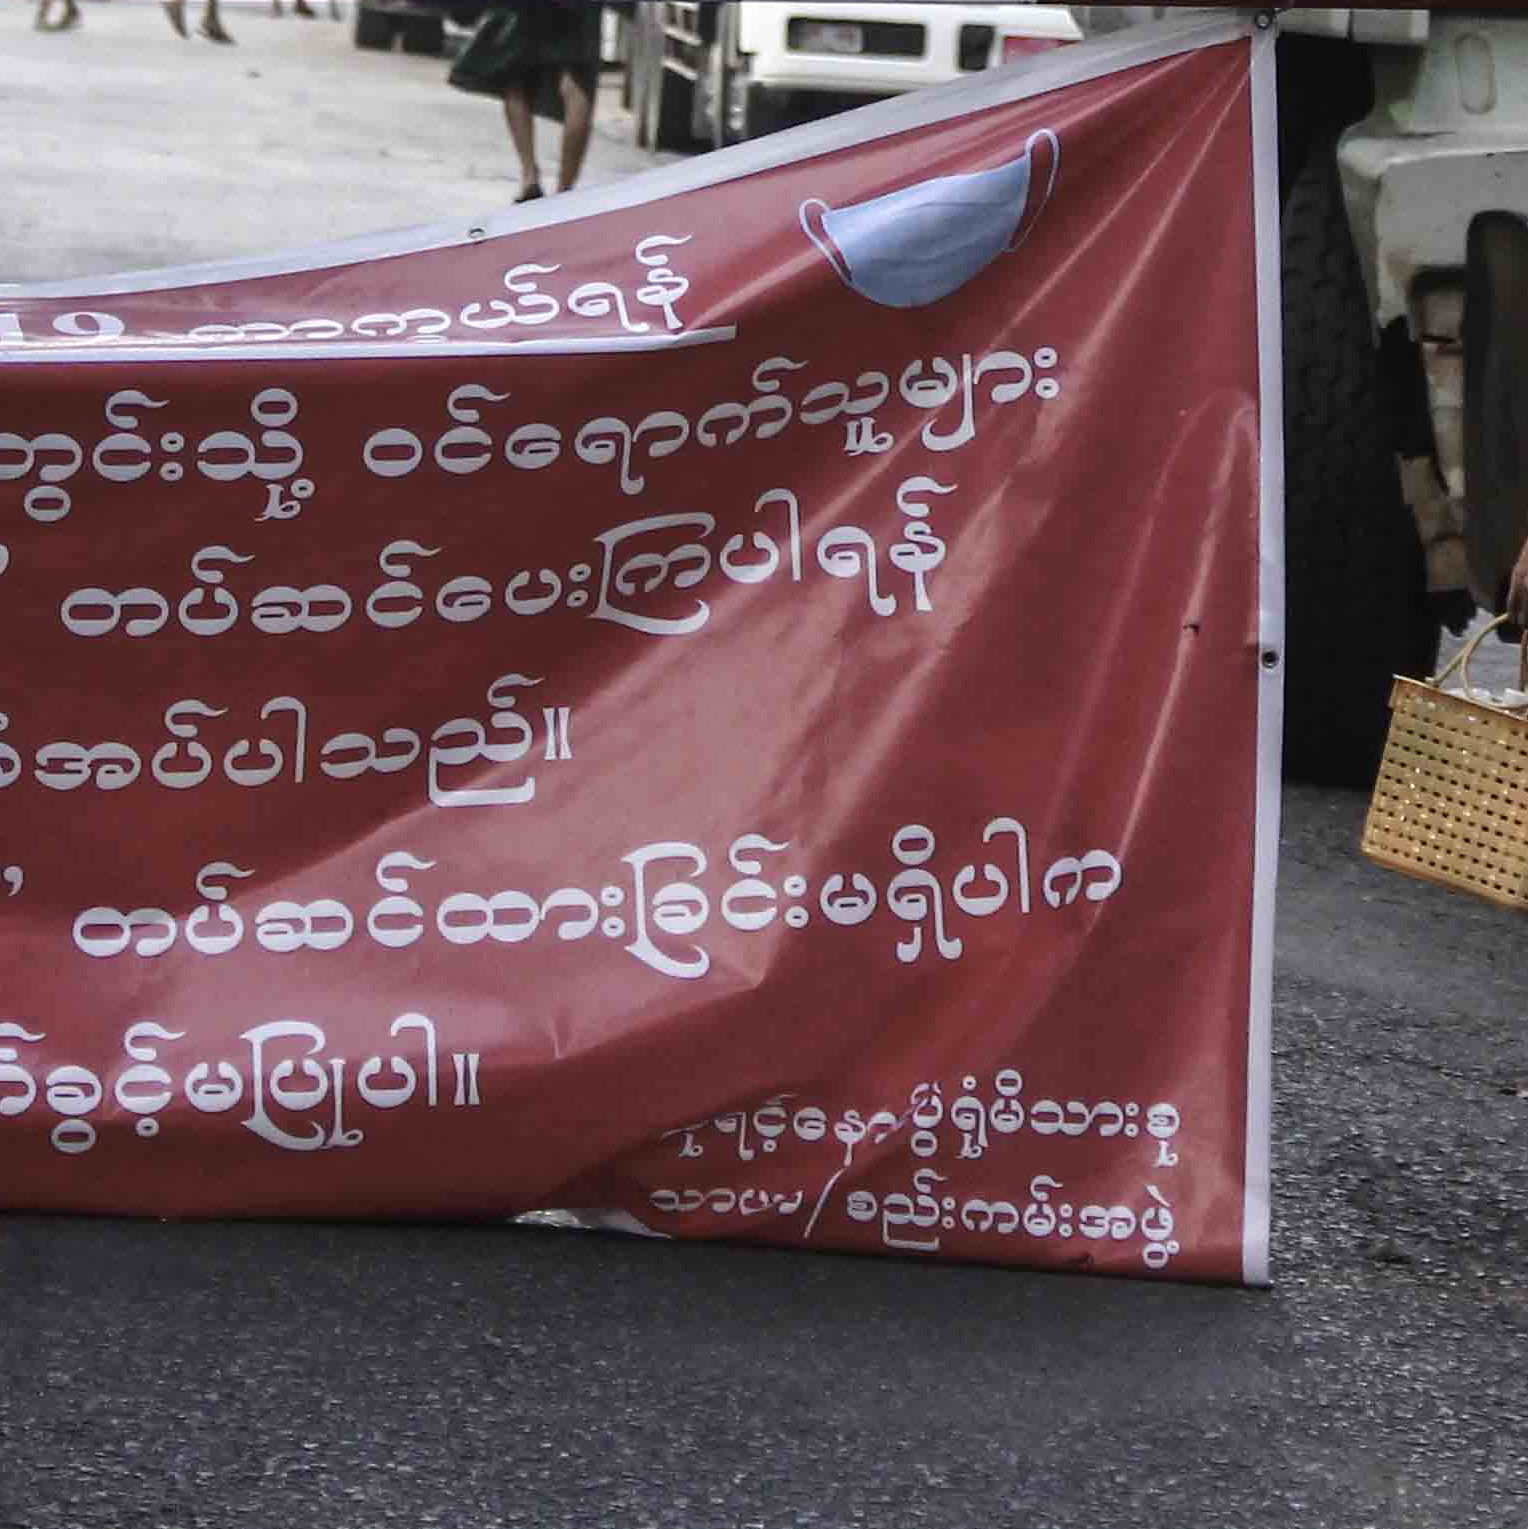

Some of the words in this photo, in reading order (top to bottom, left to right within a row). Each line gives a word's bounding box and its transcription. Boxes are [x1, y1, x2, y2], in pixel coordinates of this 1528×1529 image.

[363, 346, 1062, 495] ဝင်ရောက်သူများ
[60, 476, 958, 639] တပ်ဆင်ပေးကြပါရန်
